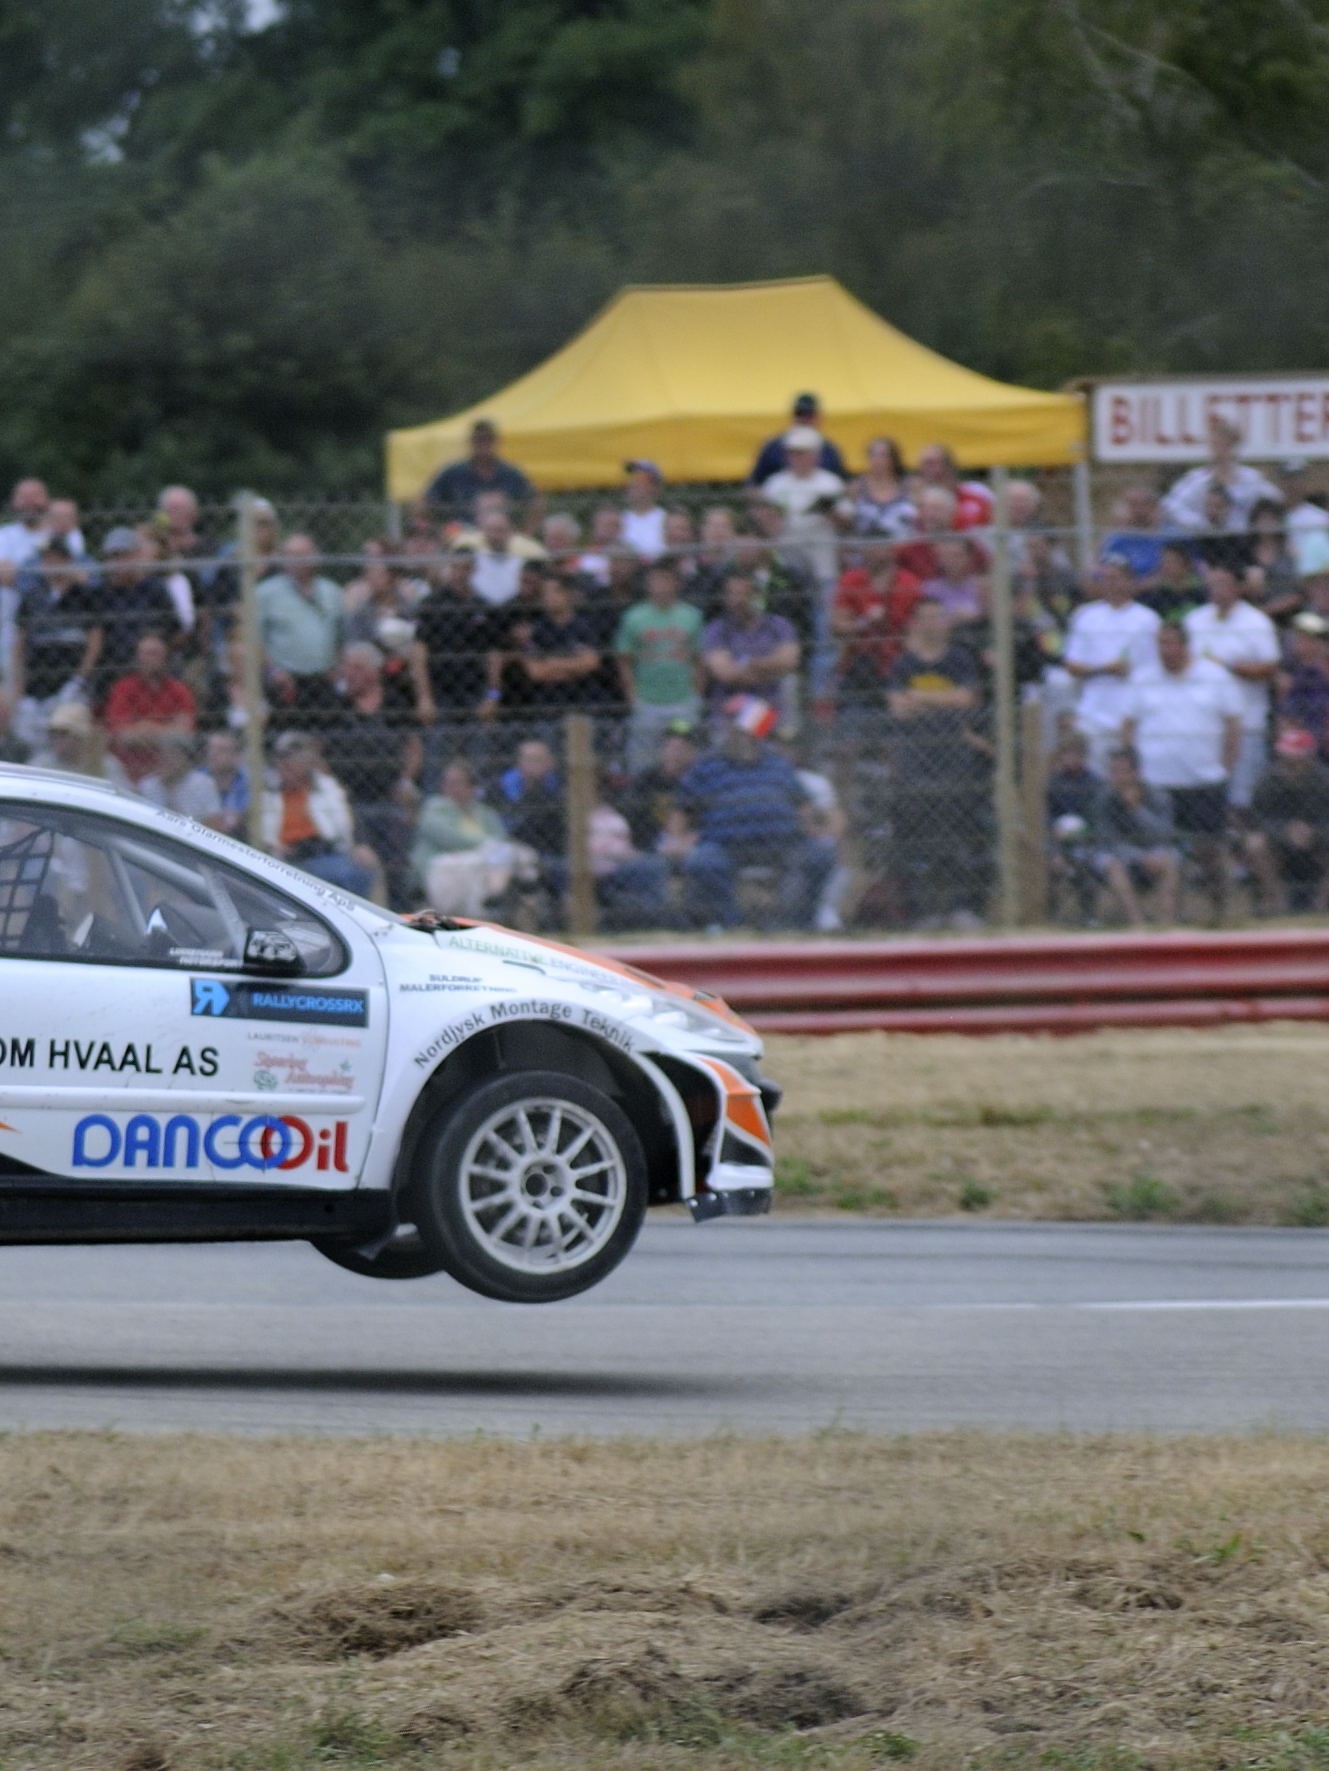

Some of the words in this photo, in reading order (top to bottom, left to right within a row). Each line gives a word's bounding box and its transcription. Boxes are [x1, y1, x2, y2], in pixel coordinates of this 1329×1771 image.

[1109, 391, 1329, 446] BILLTTE
[252, 992, 364, 1013] RALLYCROSSRX
[49, 1038, 163, 1074] HVAAL
[172, 1046, 219, 1076] AS
[413, 1011, 486, 1069] Nordjysk
[490, 1000, 572, 1020] Montage
[582, 1010, 635, 1051] Teknik
